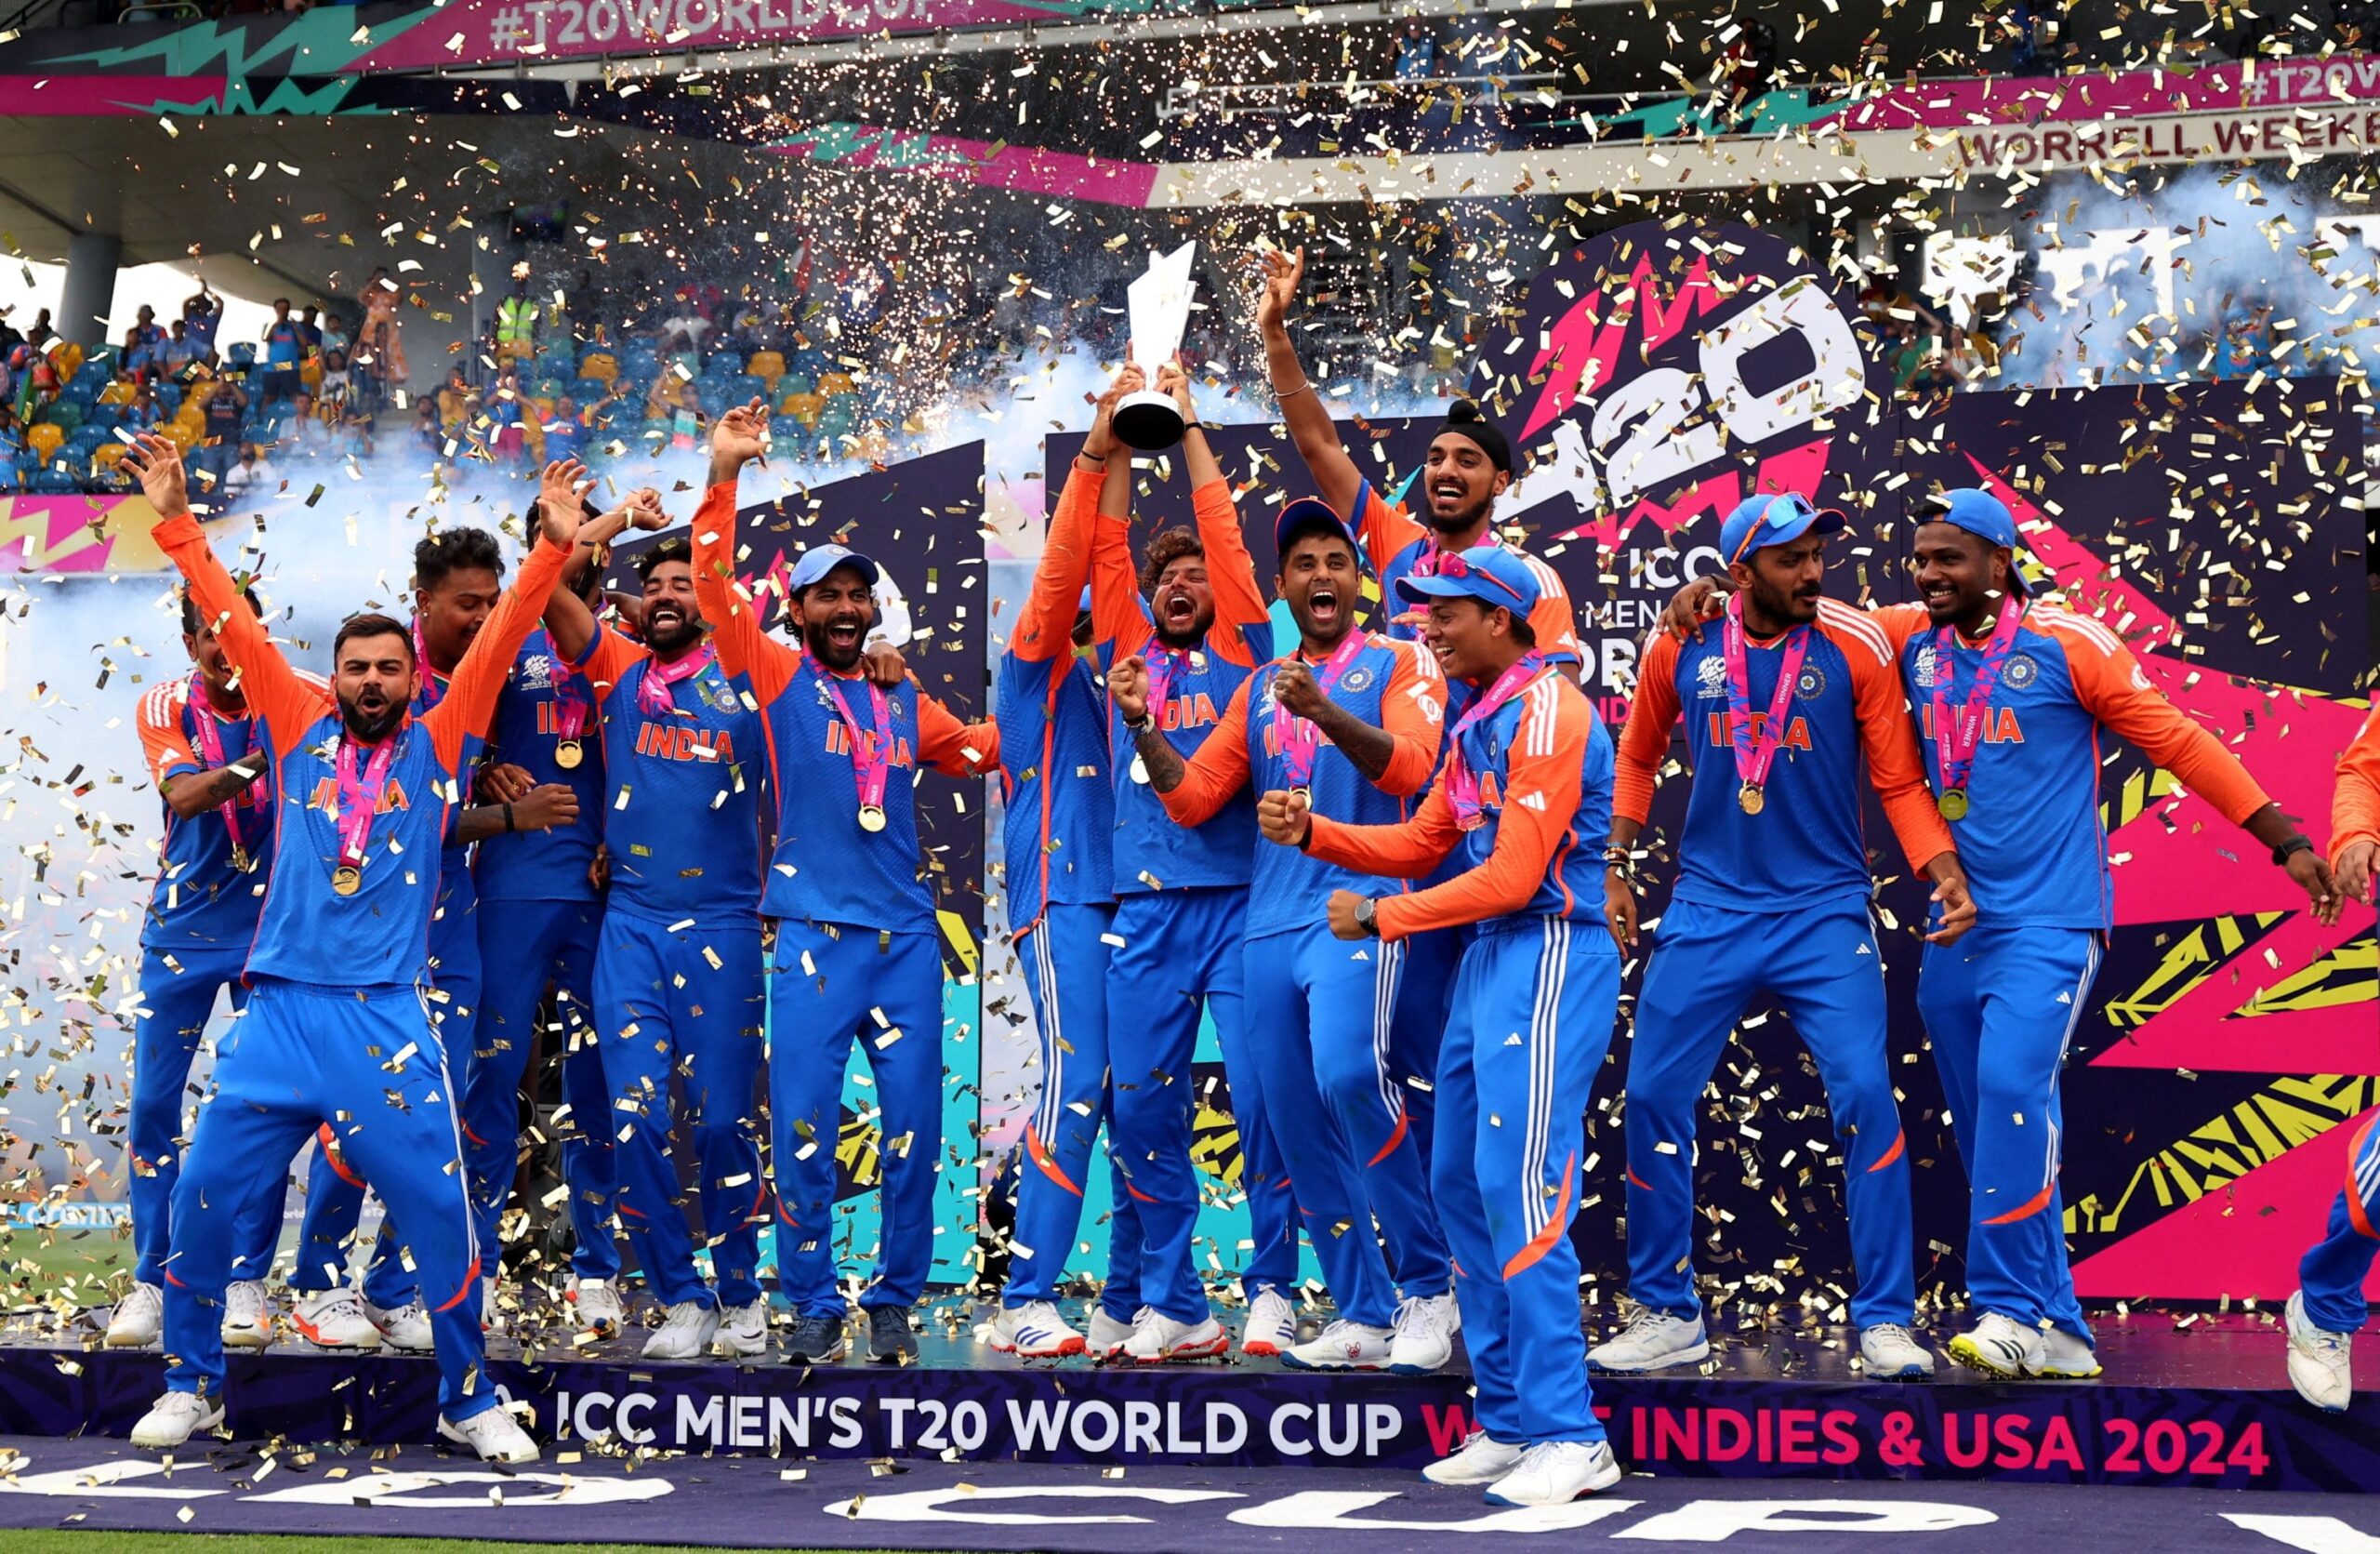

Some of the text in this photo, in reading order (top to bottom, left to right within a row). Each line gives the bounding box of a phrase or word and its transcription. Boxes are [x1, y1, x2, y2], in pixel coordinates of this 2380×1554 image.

[1958, 124, 2200, 167] WORRELL
[1585, 599, 1661, 628] MEN
[1489, 674, 1517, 702] WINNER
[1778, 672, 1792, 704] WINNER
[1161, 693, 1220, 732] DIA
[1923, 703, 2025, 743] IIA
[636, 722, 734, 764] INDIA
[1962, 715, 1977, 748] WINNER
[868, 784, 879, 805] INNER
[556, 1391, 657, 1443] ICC
[676, 1394, 863, 1449] MEN'S
[879, 1398, 987, 1451] T20
[1005, 1400, 1248, 1454] WORLD
[1269, 1402, 1402, 1456] CUP
[1633, 1407, 1860, 1465] INDIES
[1879, 1411, 1924, 1466] &
[1944, 1413, 2084, 1470] USA
[2104, 1418, 2269, 1475] 2024
